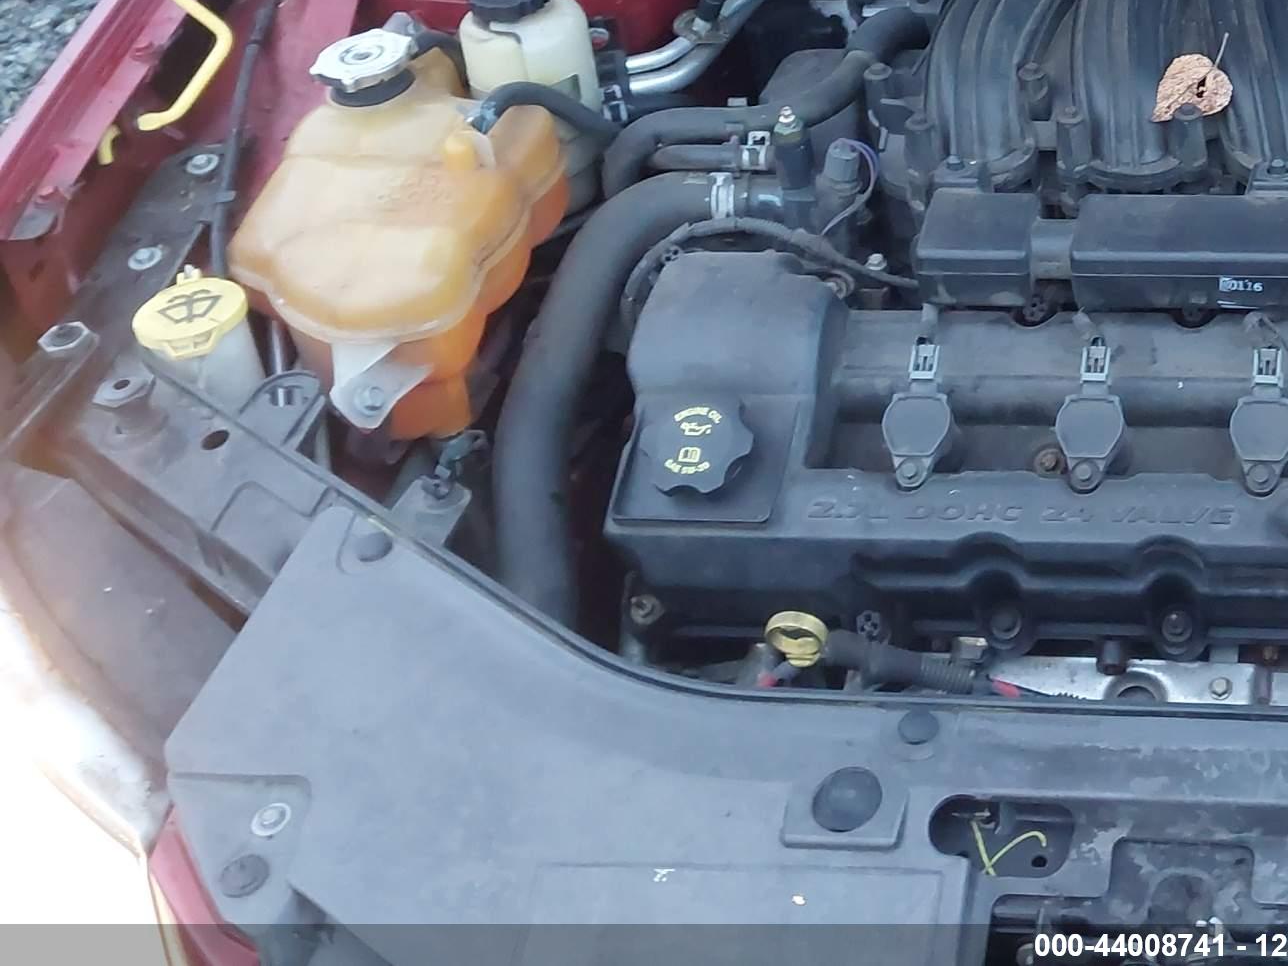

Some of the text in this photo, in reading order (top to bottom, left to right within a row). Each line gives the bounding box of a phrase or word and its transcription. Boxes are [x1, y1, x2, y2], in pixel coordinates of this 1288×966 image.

[708, 410, 722, 423] OIL
[902, 504, 1024, 522] DOHC
[1040, 505, 1093, 524] 24
[1110, 505, 1236, 526] VALVE
